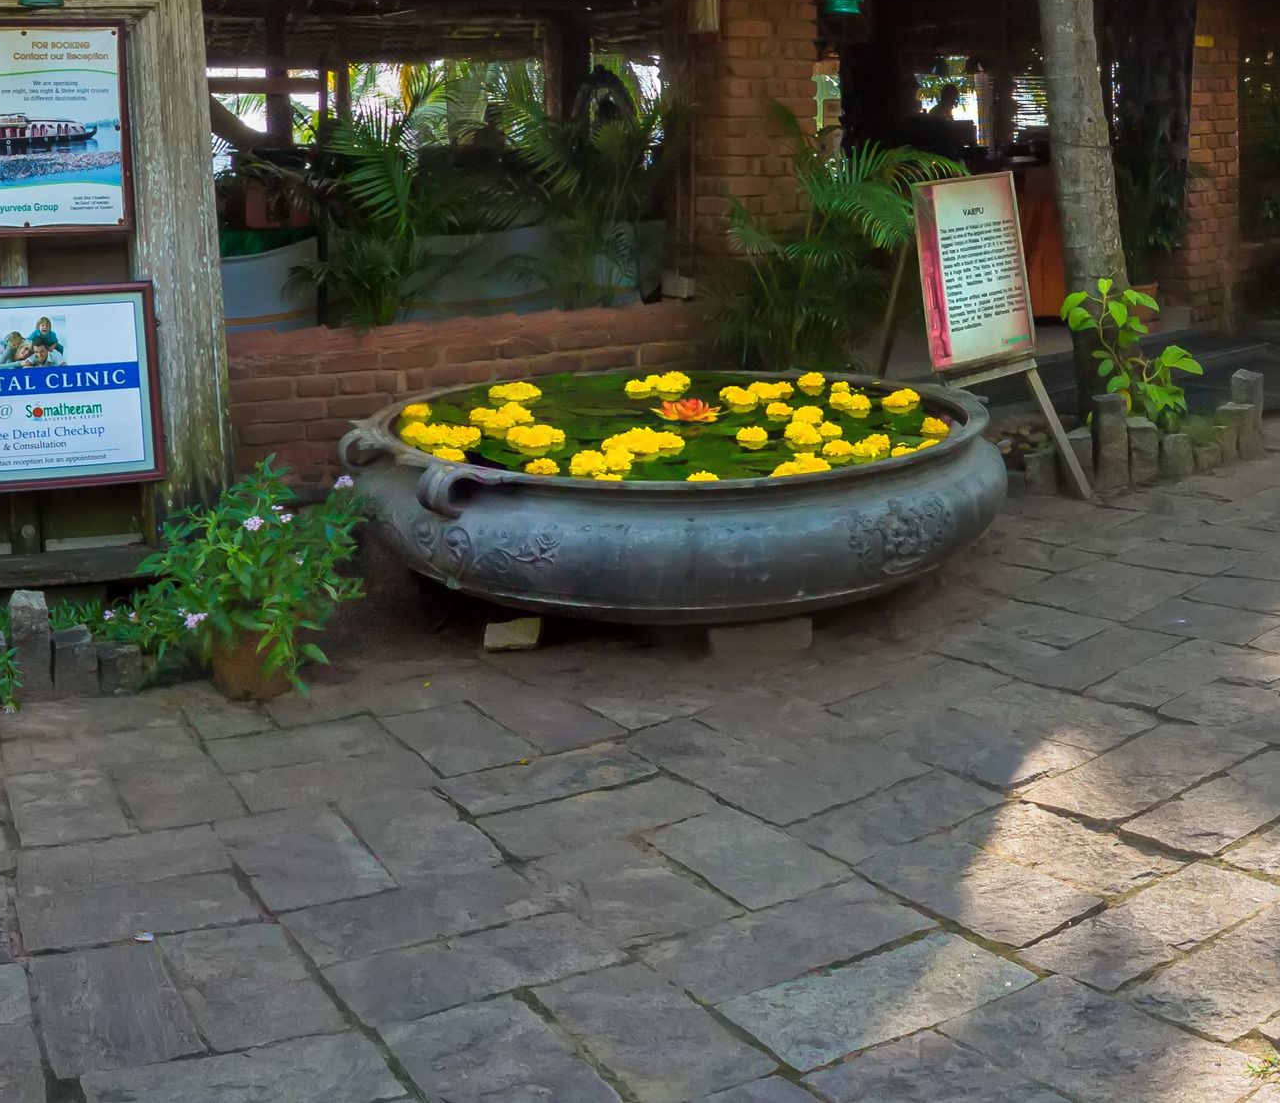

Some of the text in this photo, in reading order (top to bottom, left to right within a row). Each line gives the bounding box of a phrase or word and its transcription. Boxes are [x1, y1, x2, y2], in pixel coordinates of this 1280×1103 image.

[31, 41, 90, 49] FOR BOOKING
[13, 52, 48, 61] Contact
[66, 52, 109, 62] Reception
[33, 203, 59, 213] Group
[45, 369, 126, 388] CLINIC
[25, 403, 102, 419] Somatheeram
[12, 427, 50, 440] Dental
[54, 425, 105, 440] Checkup
[3, 440, 67, 451] & Consultation
[12, 457, 43, 467] reception
[44, 456, 54, 464] for
[65, 453, 107, 464] appointment
